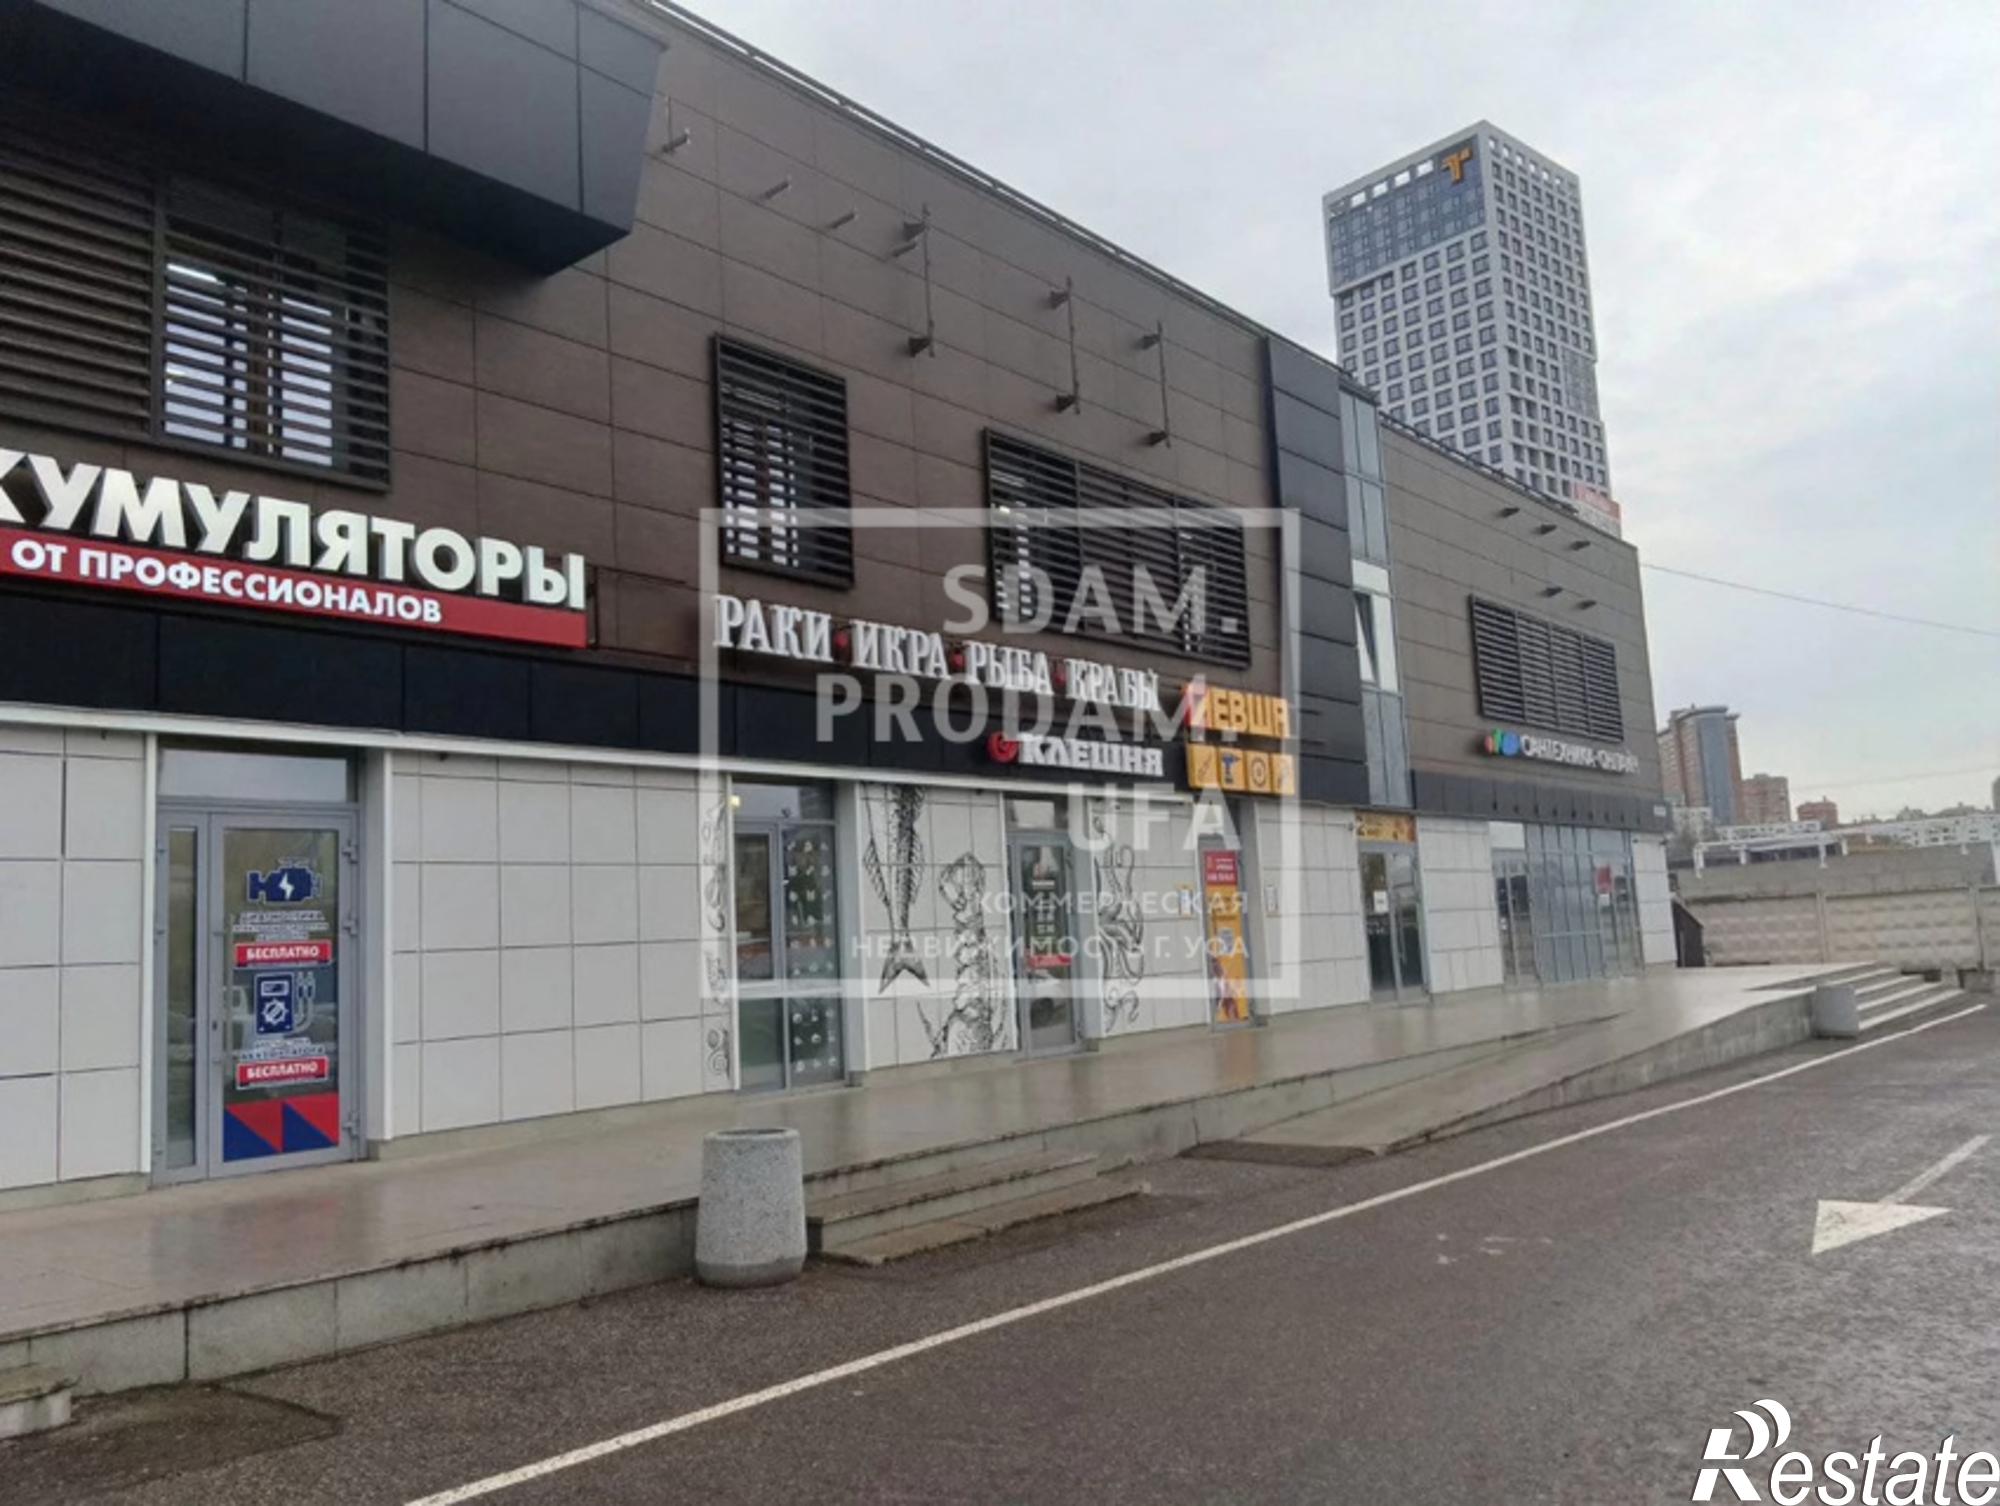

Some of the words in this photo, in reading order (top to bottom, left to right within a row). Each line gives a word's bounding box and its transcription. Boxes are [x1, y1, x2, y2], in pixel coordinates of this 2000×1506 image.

[11, 538, 68, 575] ОТ
[78, 547, 442, 625] ПРОФЕССИОНАЛОВ
[713, 595, 834, 663] РАКИ
[849, 617, 951, 681] ИКРА
[963, 639, 1054, 696] РЫБА
[1063, 656, 1161, 712] КРАБЫ
[1184, 684, 1290, 739] ЛЕВША
[1018, 732, 1164, 777] КЛЕШНЯ
[246, 945, 320, 960] БЕСПЛАТНО
[246, 1061, 319, 1079] БЕСПЛАТНО
